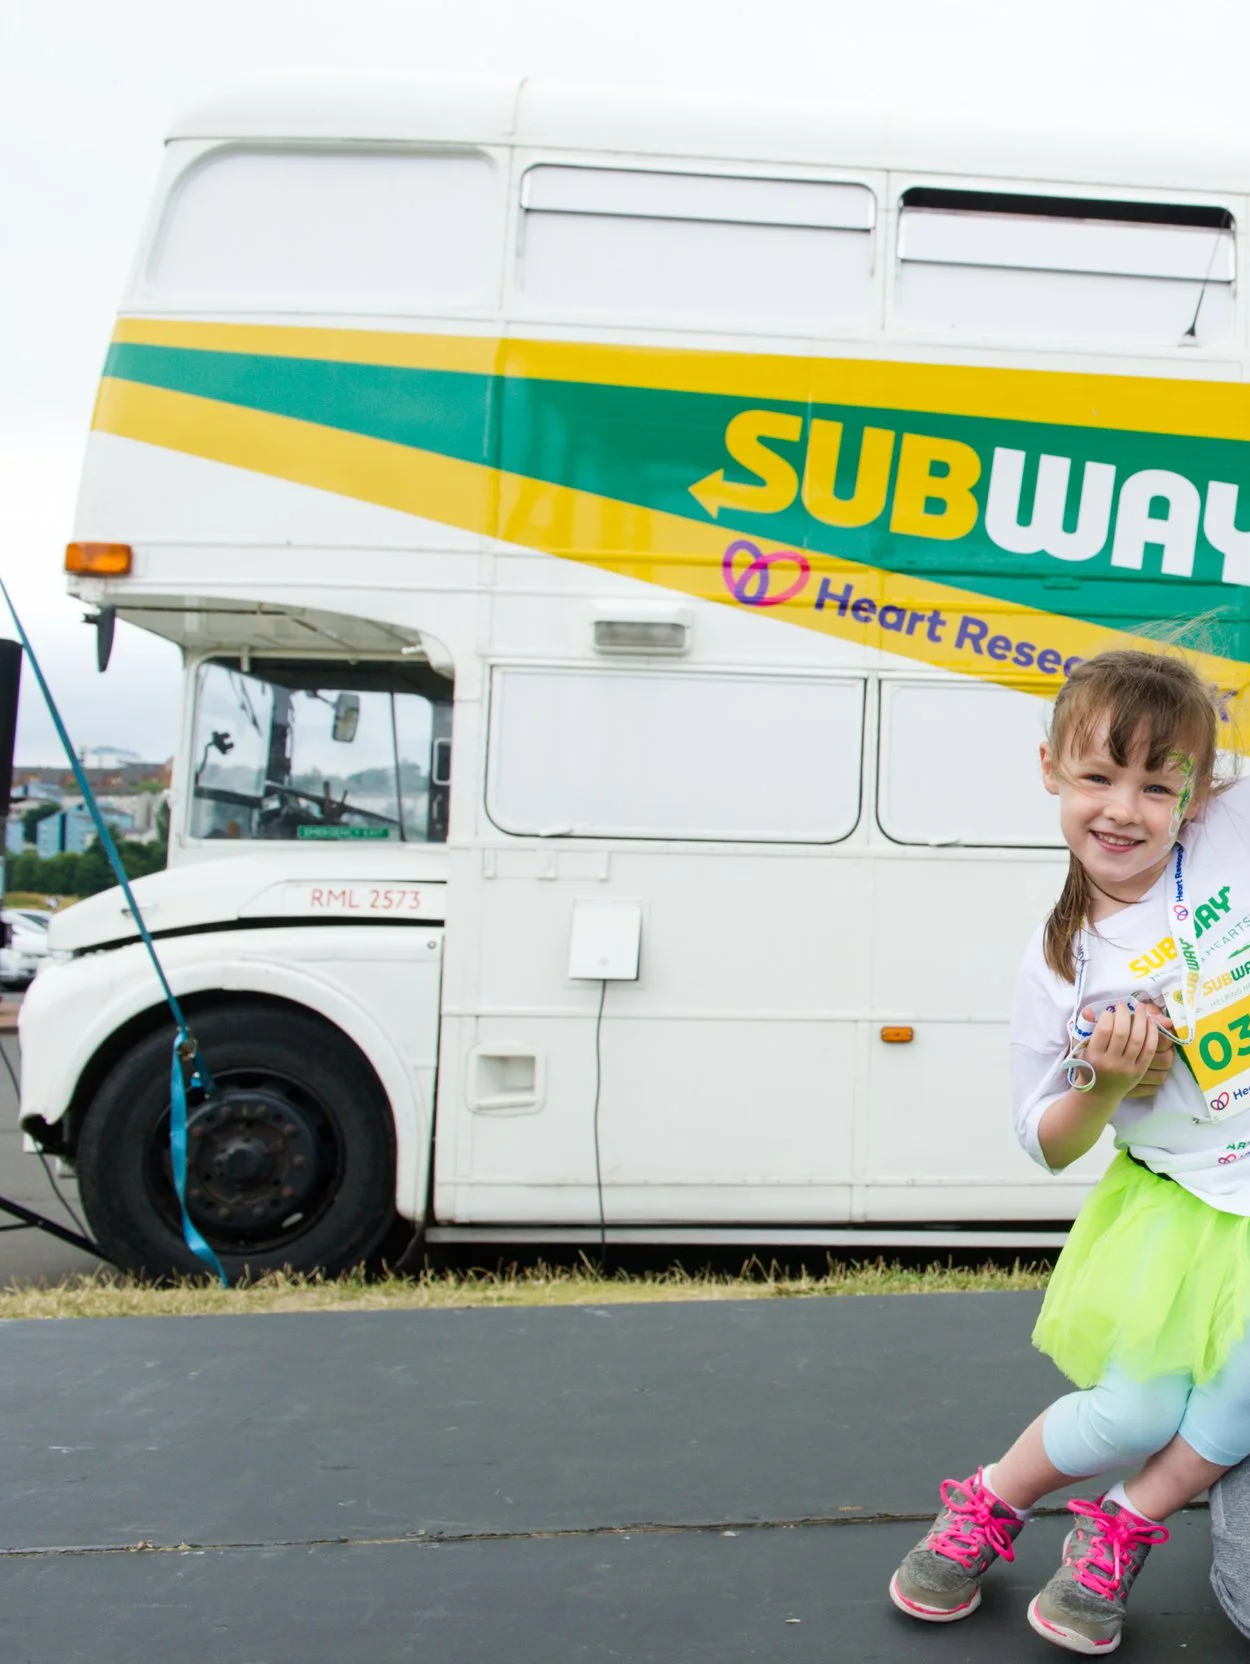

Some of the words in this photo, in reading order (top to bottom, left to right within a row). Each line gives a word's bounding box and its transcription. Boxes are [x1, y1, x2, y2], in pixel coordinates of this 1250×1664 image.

[814, 577, 947, 643] Heart
[310, 888, 360, 909] RML
[369, 889, 421, 910] 2573
[1178, 937, 1200, 1009] SUBWAY
